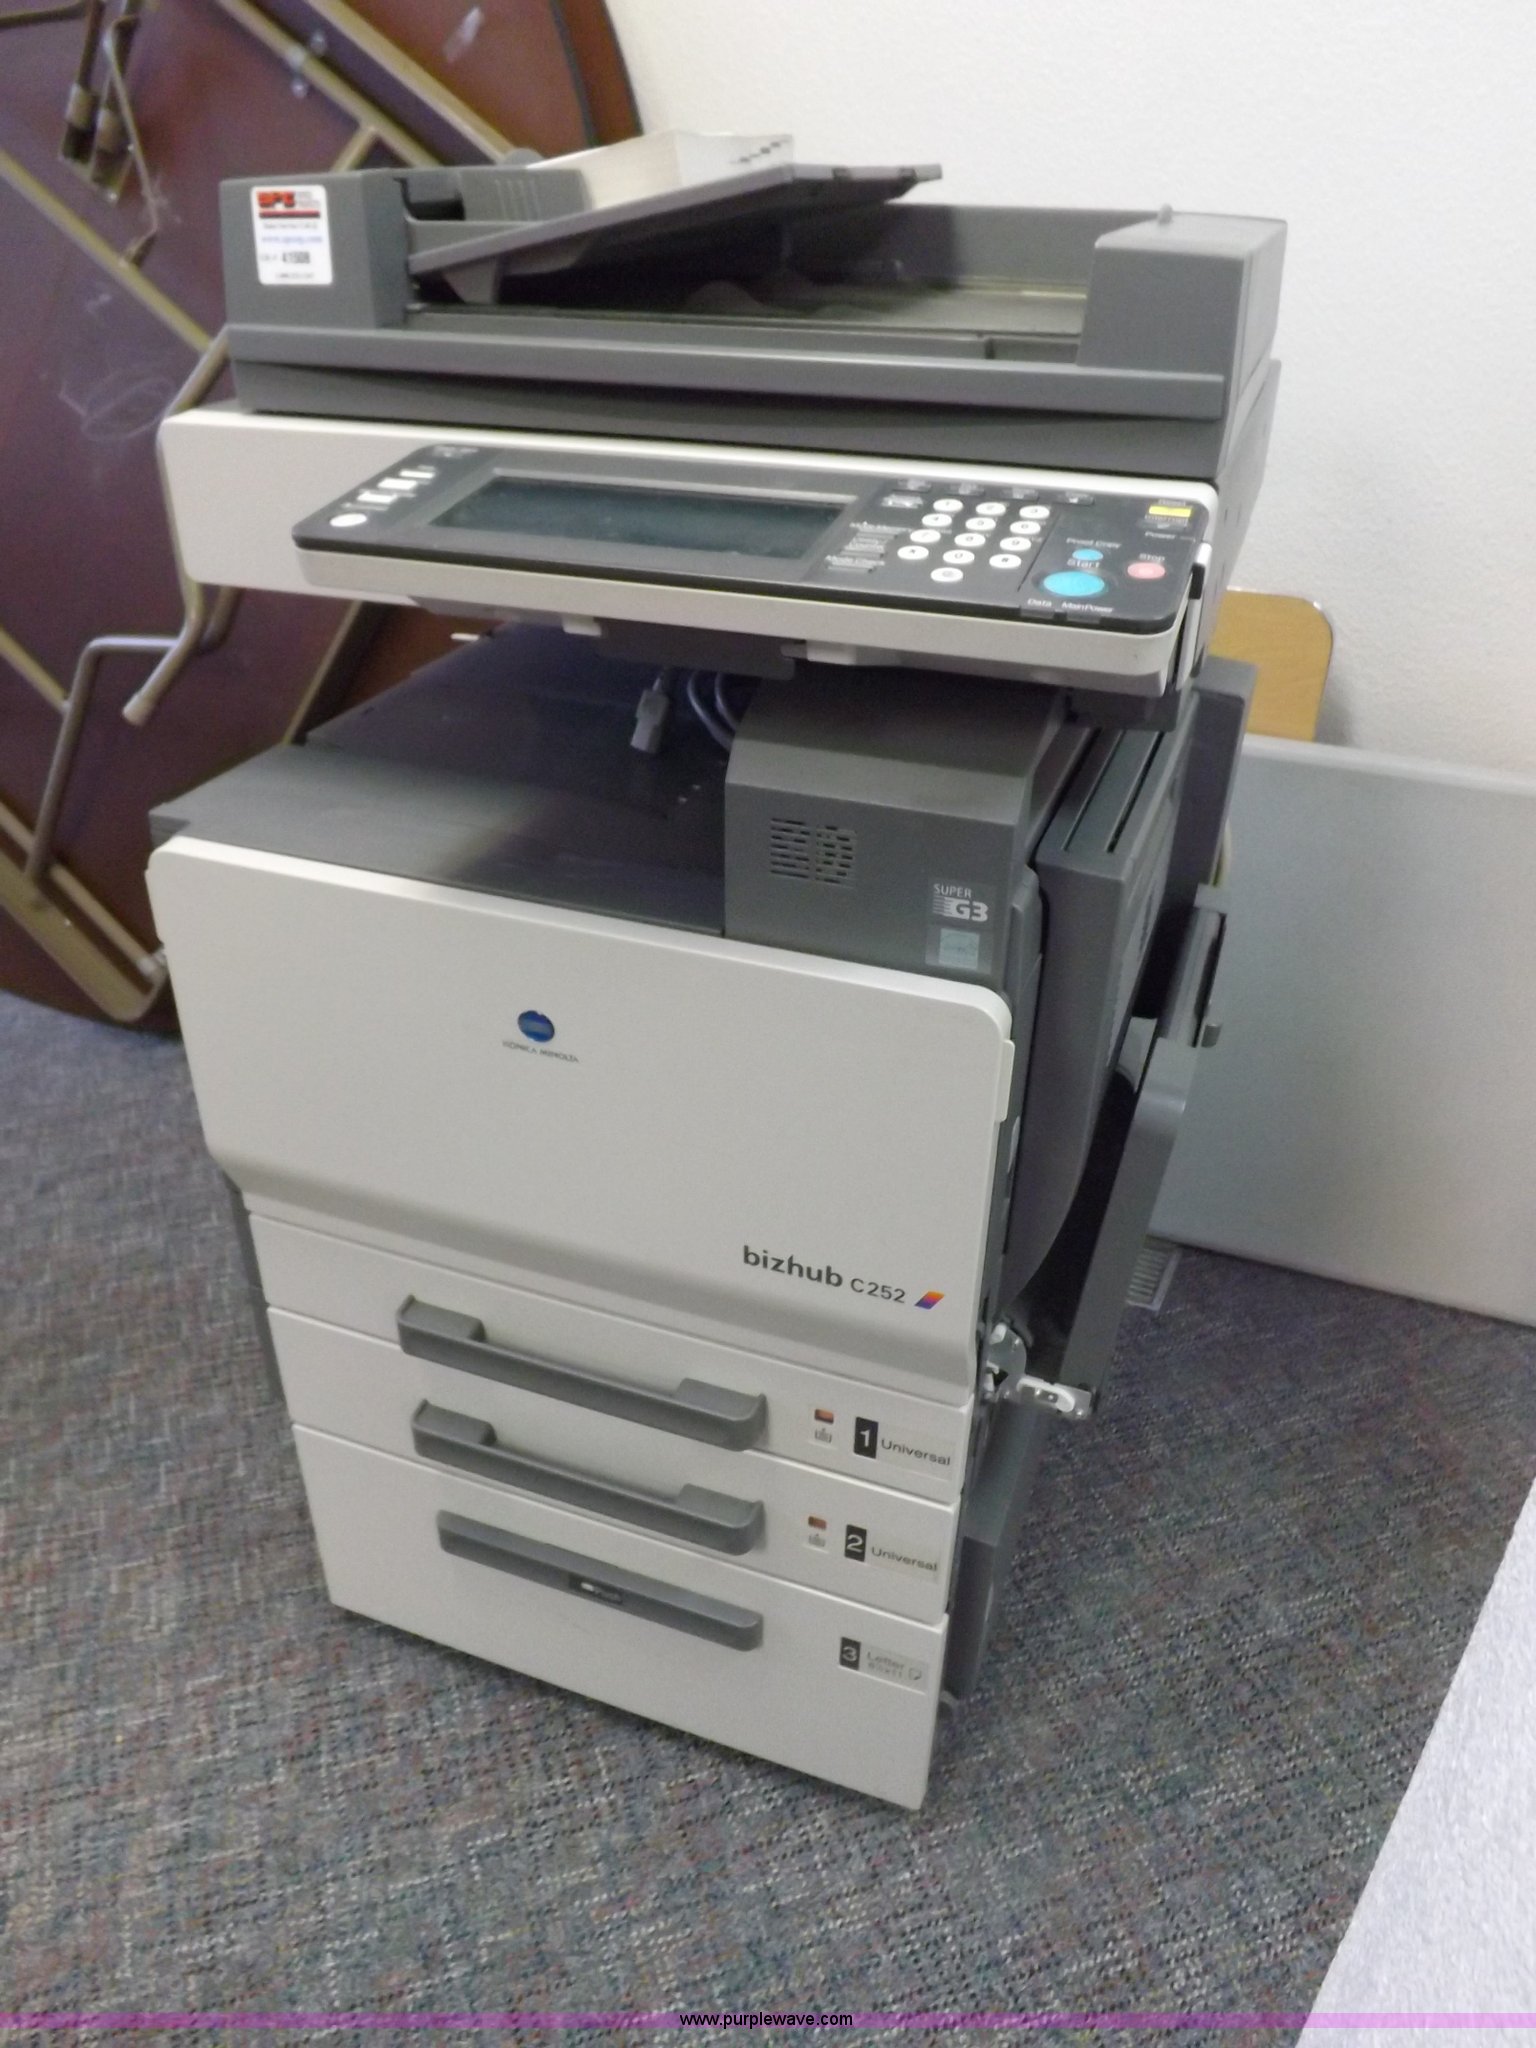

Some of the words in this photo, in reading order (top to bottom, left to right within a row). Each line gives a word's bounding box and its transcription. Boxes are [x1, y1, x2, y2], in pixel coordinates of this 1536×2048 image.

[1067, 559, 1101, 569] Start
[1139, 553, 1166, 562] Stop
[1027, 598, 1053, 608] Data
[933, 883, 972, 899] SUPER
[743, 1245, 843, 1288] bizhub
[850, 1278, 906, 1304] C252
[860, 1429, 870, 1448] 1
[881, 1438, 951, 1466] Universal
[847, 1534, 864, 1554] 2
[872, 1546, 938, 1571] Universal
[842, 1646, 858, 1662] 3
